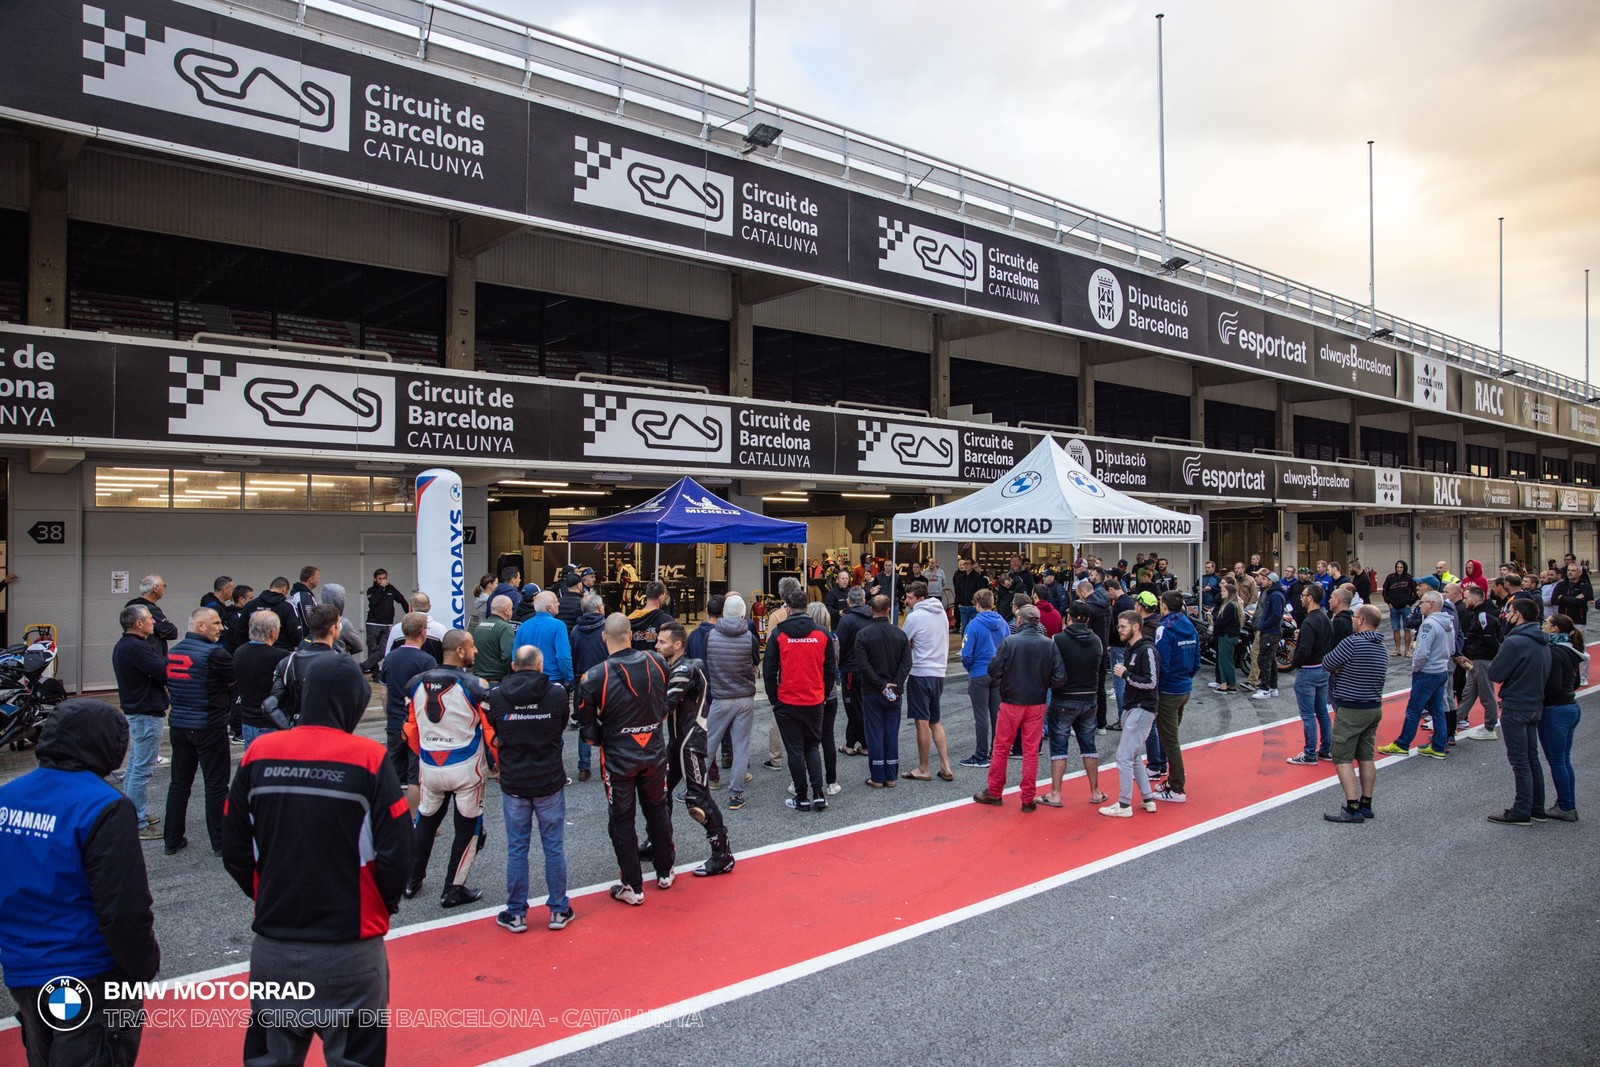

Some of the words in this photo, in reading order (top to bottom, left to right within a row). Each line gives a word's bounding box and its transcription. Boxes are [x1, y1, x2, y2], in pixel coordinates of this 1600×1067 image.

[365, 84, 451, 124] Circuit
[456, 106, 485, 131] de
[365, 110, 484, 156] Barcelona
[364, 139, 484, 180] CATALUNYA
[742, 182, 797, 212] Circuit
[800, 197, 818, 217] de
[742, 203, 818, 237] Barcelona
[741, 225, 818, 255] CATALUNYA
[988, 247, 1025, 270] Circuit
[1026, 257, 1039, 274] de
[989, 264, 1039, 290] Barcelona
[988, 283, 1040, 305] CATALUNYA
[1128, 285, 1188, 317] Diputació
[1129, 309, 1189, 339] Barcelona
[13, 343, 56, 371] de
[1238, 328, 1307, 364] esportcat
[407, 380, 485, 407] Circuit
[488, 387, 514, 409] de
[1475, 380, 1504, 417] RACC
[408, 405, 514, 432] Barcelona
[739, 409, 791, 431] Circuit
[793, 414, 811, 432] de
[407, 431, 514, 453] CATALUNYA
[739, 429, 811, 451] Barcelona
[963, 431, 1000, 449] Circuit
[1001, 435, 1014, 450] de
[739, 450, 811, 468] CATALUNYA
[964, 448, 1014, 466] Barcelona
[1095, 448, 1147, 469] Diputació
[963, 466, 1010, 480] CATALUN
[1095, 468, 1147, 486] Barcelona
[1202, 467, 1266, 493] esportcat
[1433, 476, 1462, 506] RACC
[37, 525, 63, 540] 38
[910, 518, 950, 534] BMW
[953, 518, 1053, 534] MOTORRAD
[1092, 518, 1124, 535] BMW
[1127, 518, 1191, 535] MOTORRAD
[450, 508, 465, 631] ACKDAYS
[621, 722, 660, 734] DAINESE
[8, 809, 57, 833] YAMAHA
